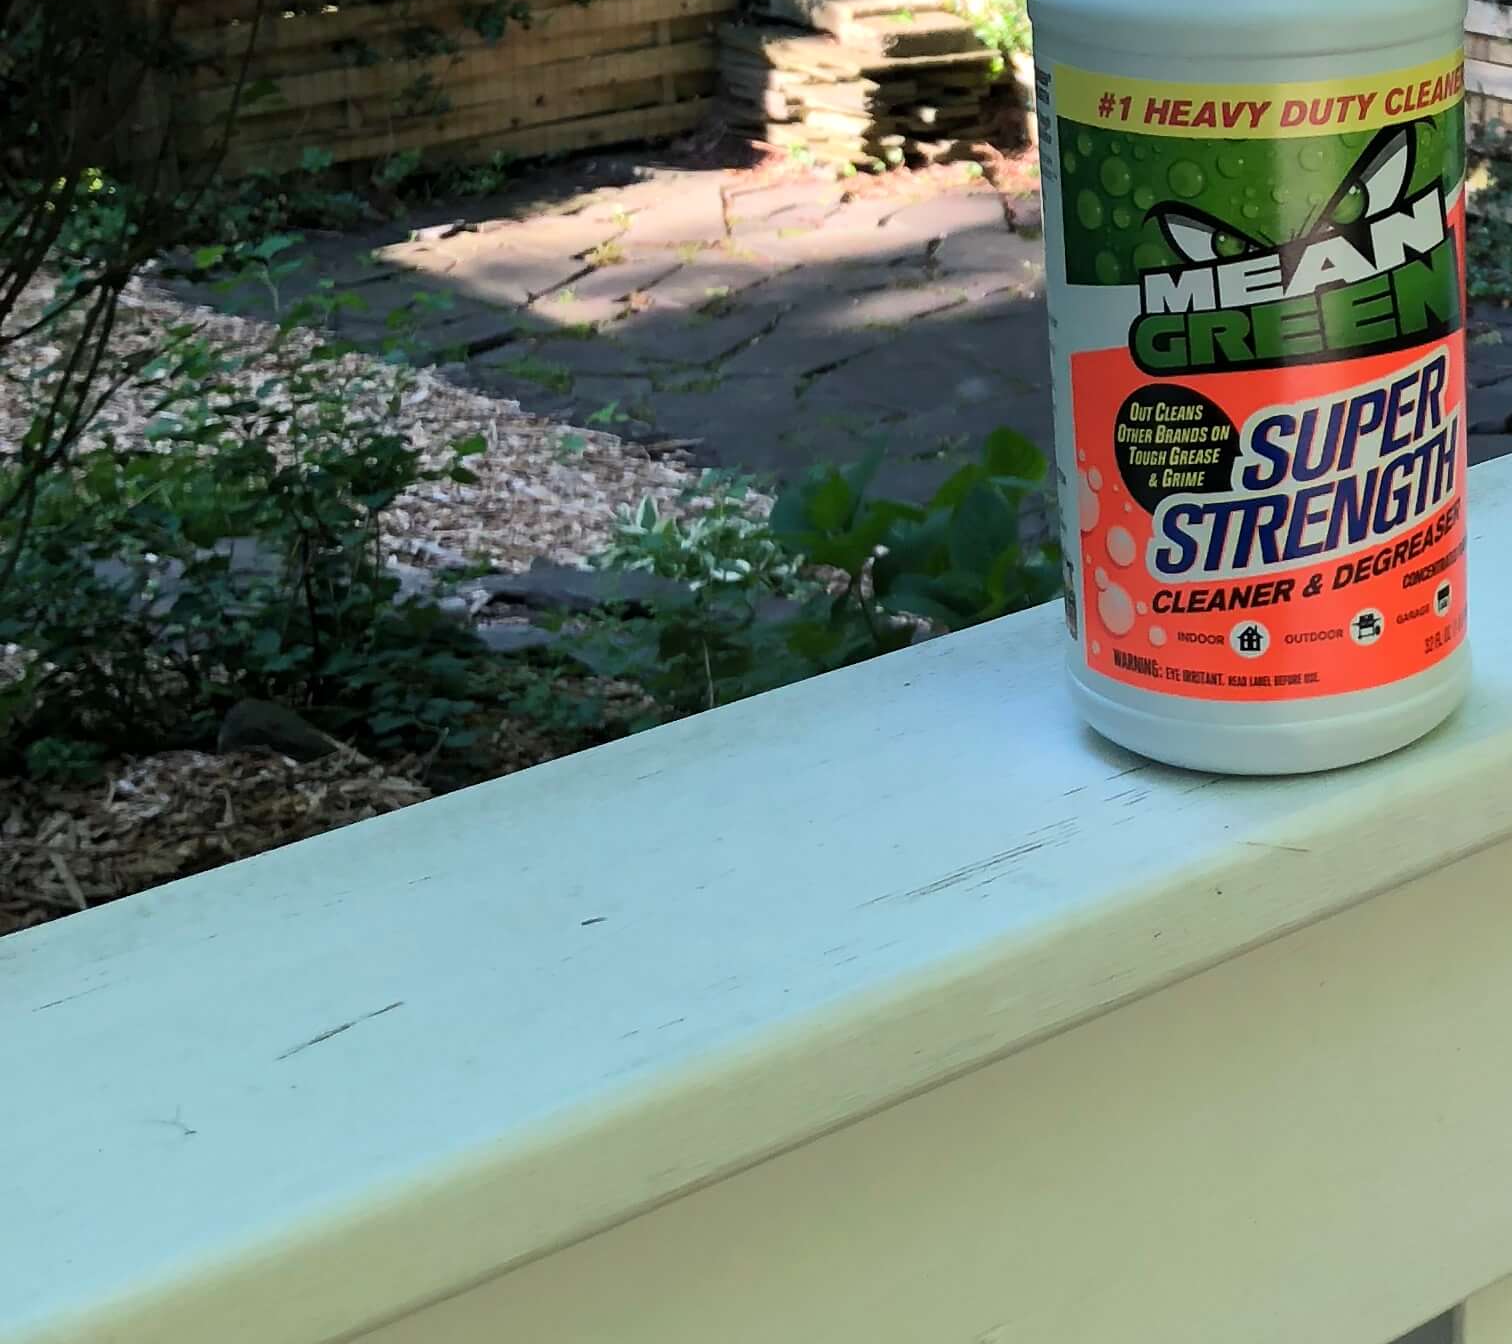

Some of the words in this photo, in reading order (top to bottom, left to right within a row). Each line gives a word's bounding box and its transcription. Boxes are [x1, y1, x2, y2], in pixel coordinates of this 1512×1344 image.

[1098, 91, 1132, 121] #1
[1144, 97, 1272, 129] HEAVY
[1280, 92, 1378, 129] DUTY
[1143, 186, 1446, 315] MEAN
[1133, 244, 1454, 372] GREEN
[1130, 403, 1153, 421] OUT
[1155, 404, 1203, 422] CLEANS
[1242, 355, 1447, 491] SUPER
[1118, 425, 1153, 444] OTHER
[1156, 426, 1208, 444] BRANDS
[1211, 425, 1230, 441] ON
[1129, 447, 1166, 466] TOUGH
[1169, 447, 1220, 466] GREASE
[1148, 473, 1158, 488] &
[1162, 470, 1205, 488] GRIME
[1155, 418, 1459, 575] STRENGTH
[1151, 580, 1296, 614] CLEANER
[1302, 574, 1322, 596] &
[1396, 604, 1430, 625] GARAGE
[1177, 632, 1225, 646] INDOOR
[1284, 628, 1344, 645] OUTDOOR
